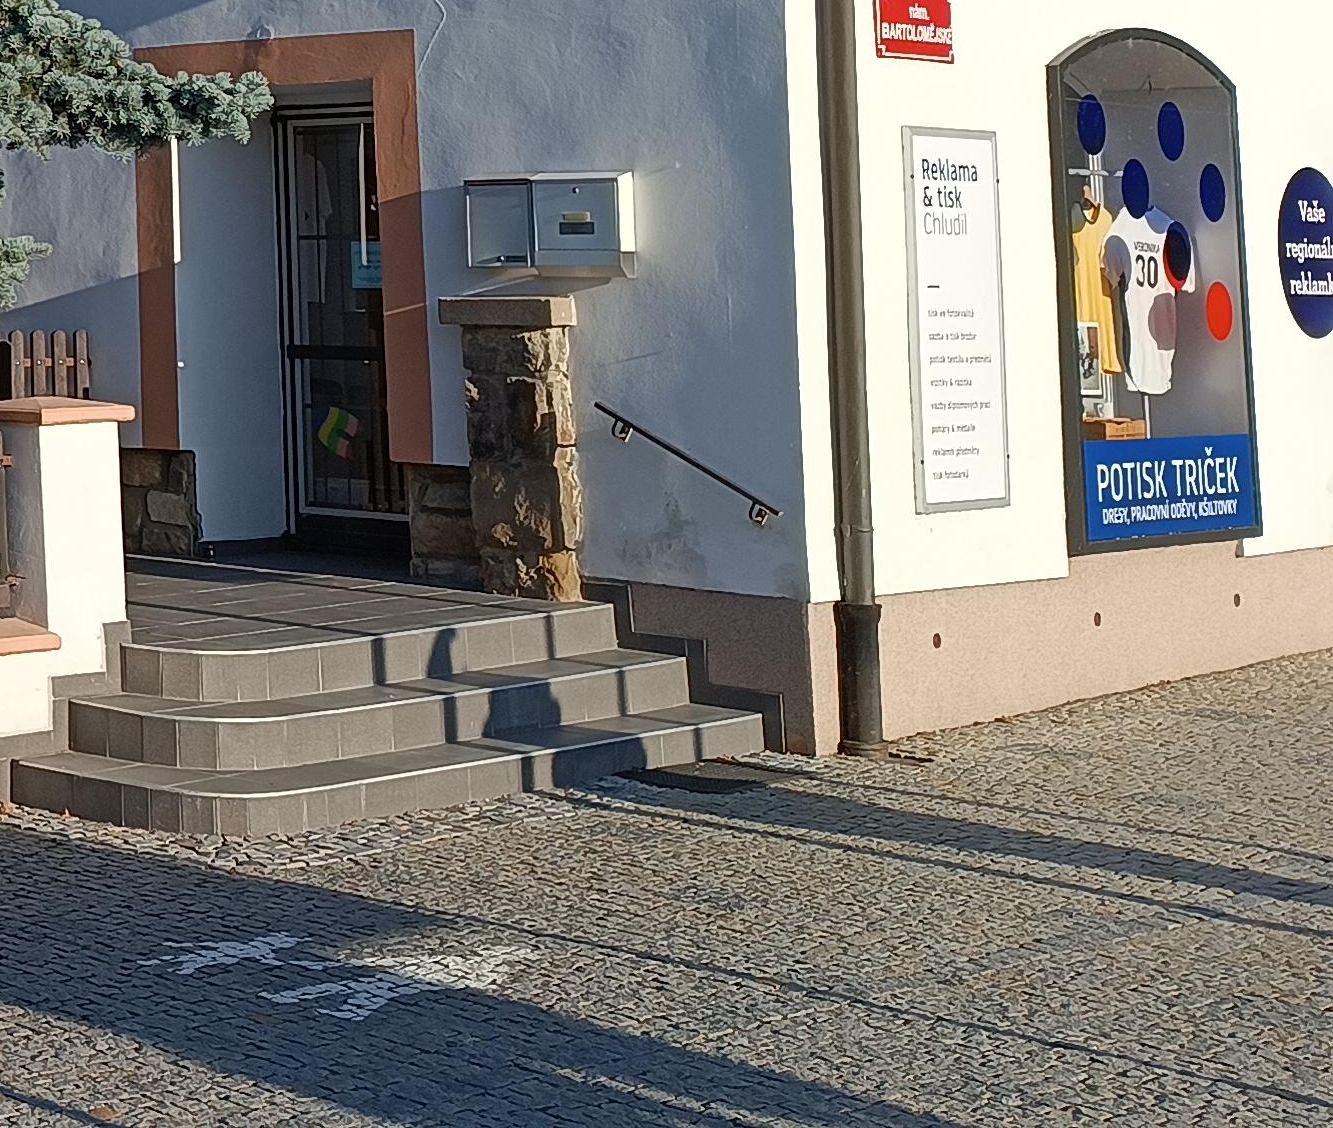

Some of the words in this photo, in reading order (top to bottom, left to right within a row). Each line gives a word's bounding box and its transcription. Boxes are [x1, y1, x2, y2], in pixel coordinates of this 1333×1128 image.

[921, 158, 978, 181] Reklama
[923, 186, 933, 207] &
[937, 185, 963, 208] tisk
[924, 211, 968, 236] Chludil
[1298, 200, 1326, 223] Vaše
[1135, 255, 1159, 288] 30
[1096, 460, 1168, 503] POTISK
[1171, 446, 1240, 497] TRIČEK
